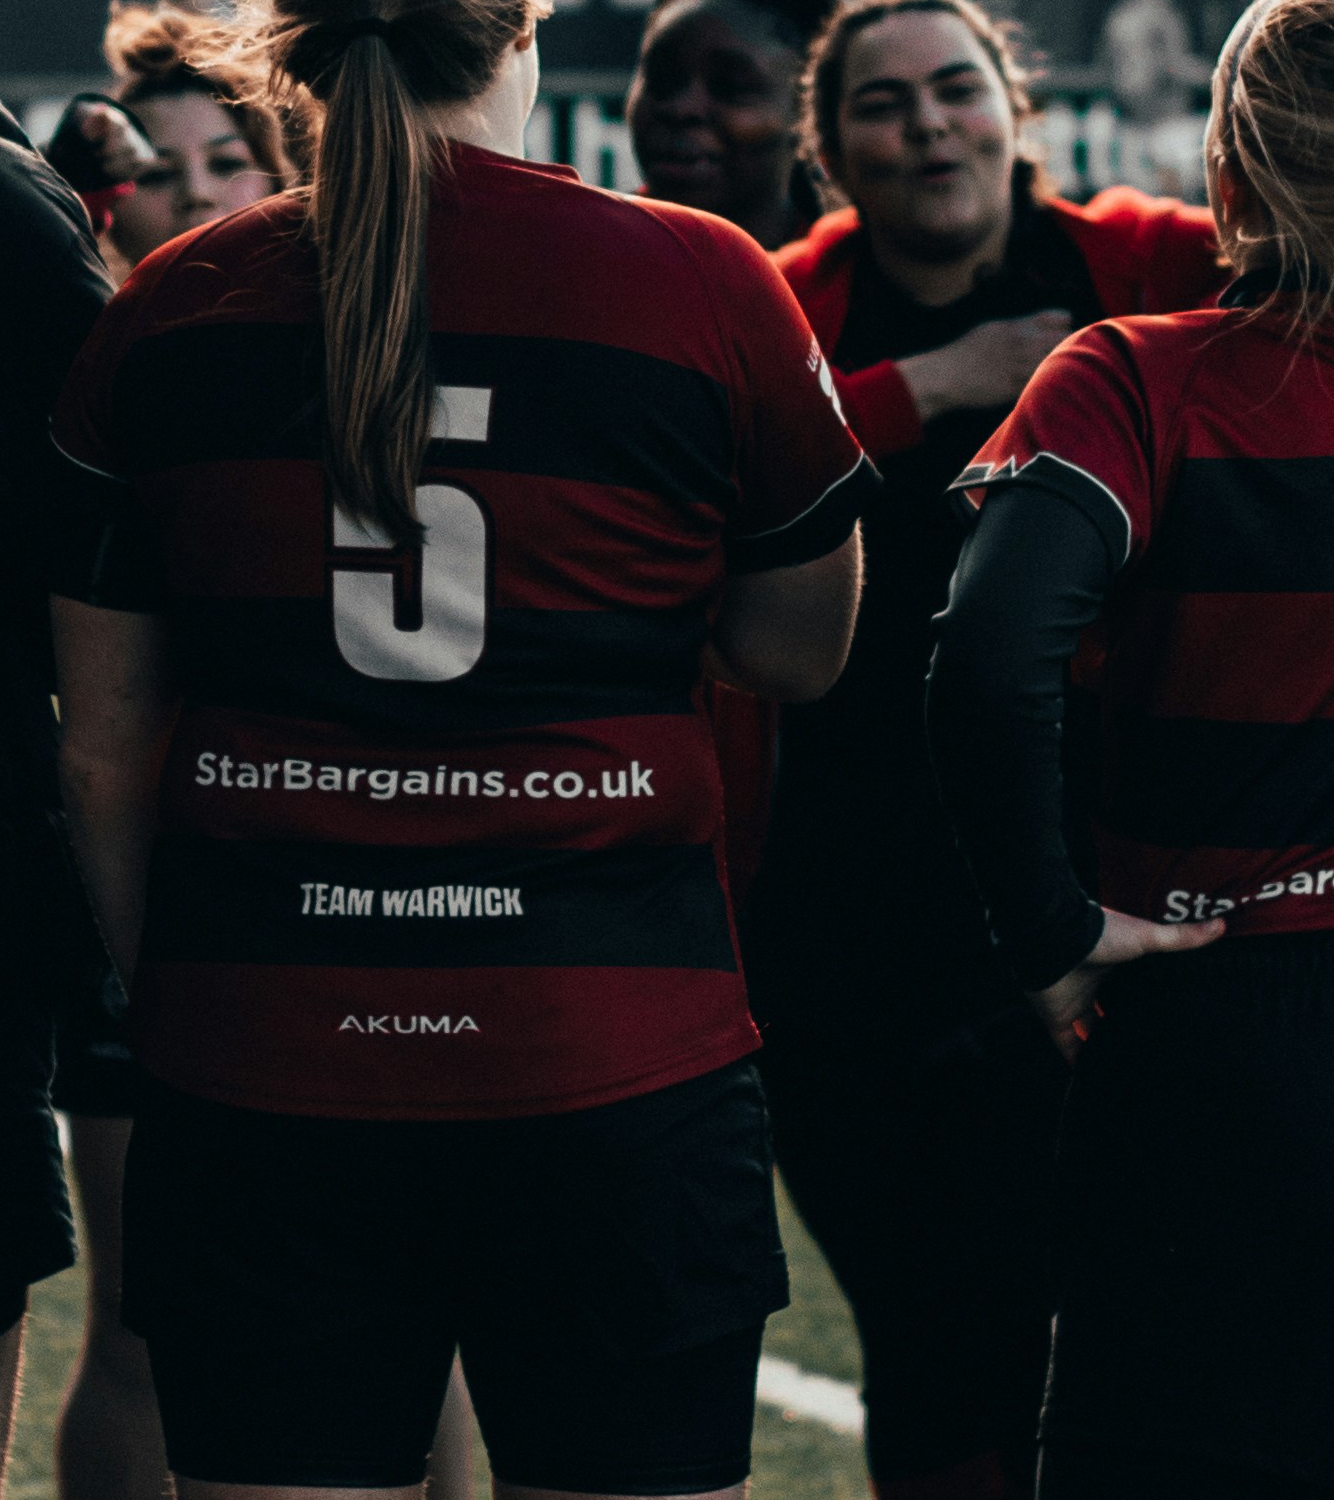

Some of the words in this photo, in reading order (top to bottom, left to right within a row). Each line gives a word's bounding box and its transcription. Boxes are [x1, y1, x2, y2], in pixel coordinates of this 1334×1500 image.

[331, 386, 495, 682] 5
[195, 751, 656, 801] StarBargains.co.uk
[299, 883, 374, 917] TEAM
[381, 885, 525, 918] WARWICK
[338, 1014, 481, 1034] AKUMA
